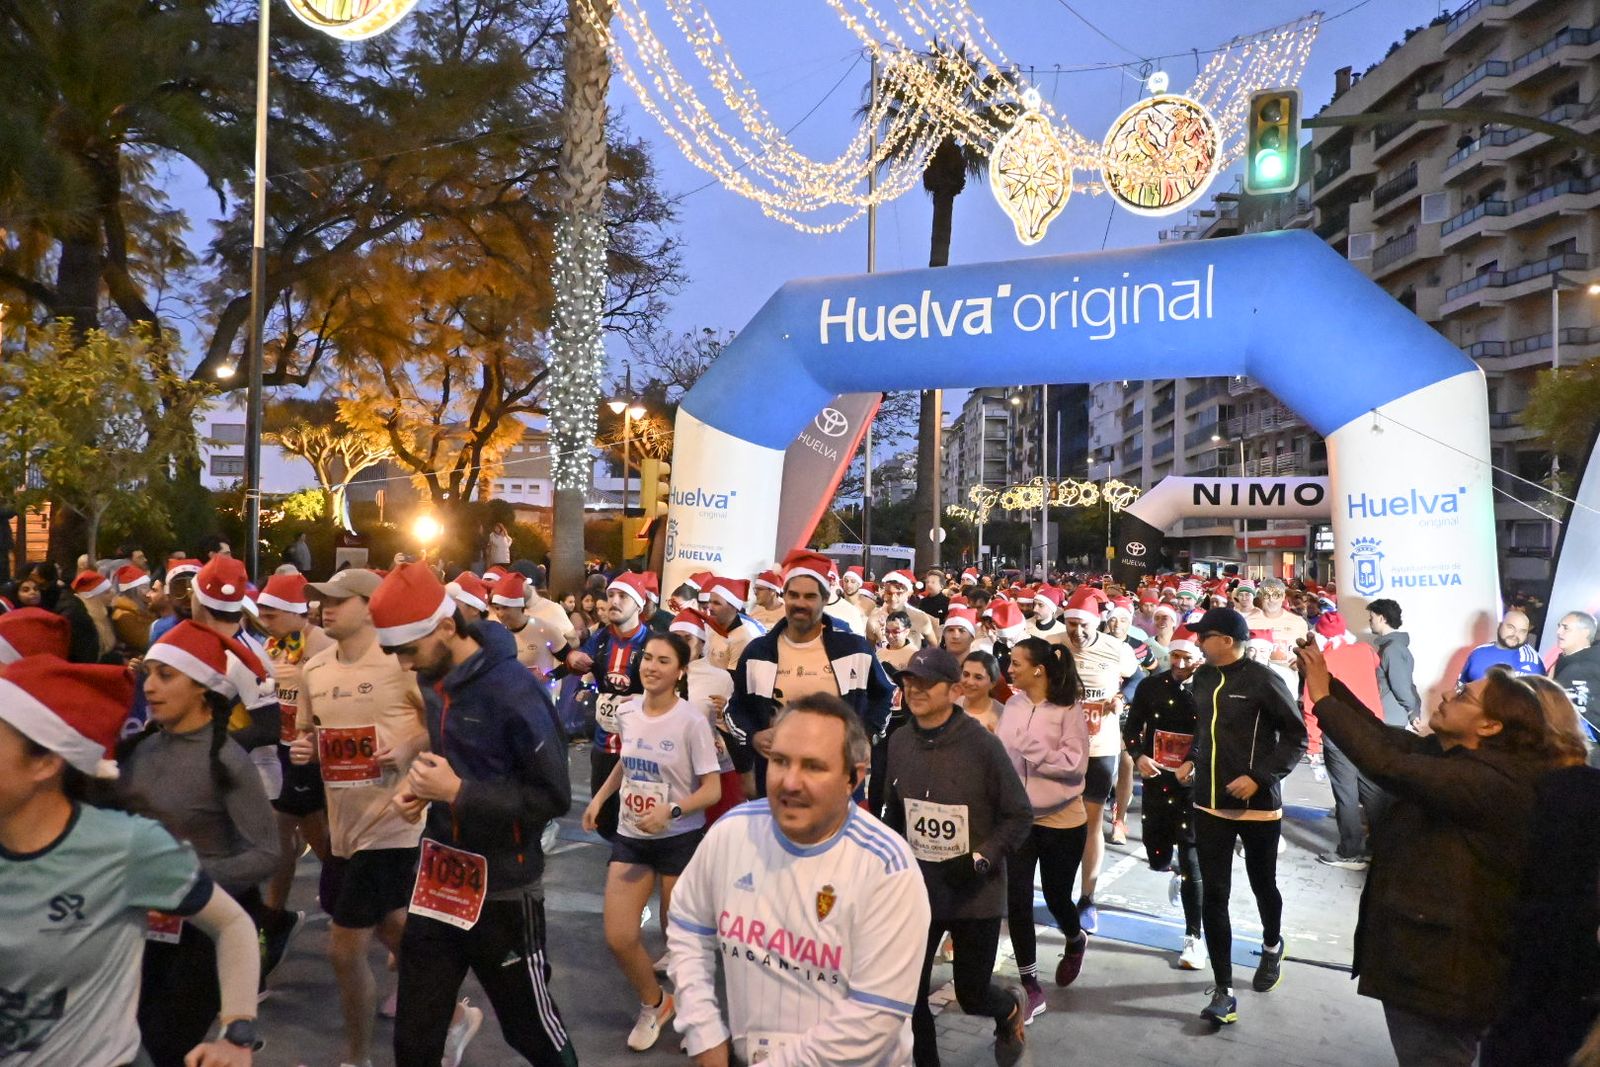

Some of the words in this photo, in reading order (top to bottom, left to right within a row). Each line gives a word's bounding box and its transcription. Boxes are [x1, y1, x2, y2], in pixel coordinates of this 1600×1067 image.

[820, 290, 992, 344] Huelva
[1013, 264, 1214, 341] original
[798, 432, 838, 461] HUELVA
[670, 486, 728, 509] Huelva
[1193, 483, 1325, 506] NIMO
[1347, 488, 1458, 518] Huelva
[679, 549, 722, 562] HUELVA
[1121, 558, 1146, 568] HUELVA
[1391, 573, 1462, 587] HUELVA
[914, 816, 956, 840] 499
[719, 911, 842, 970] CARAVAN
